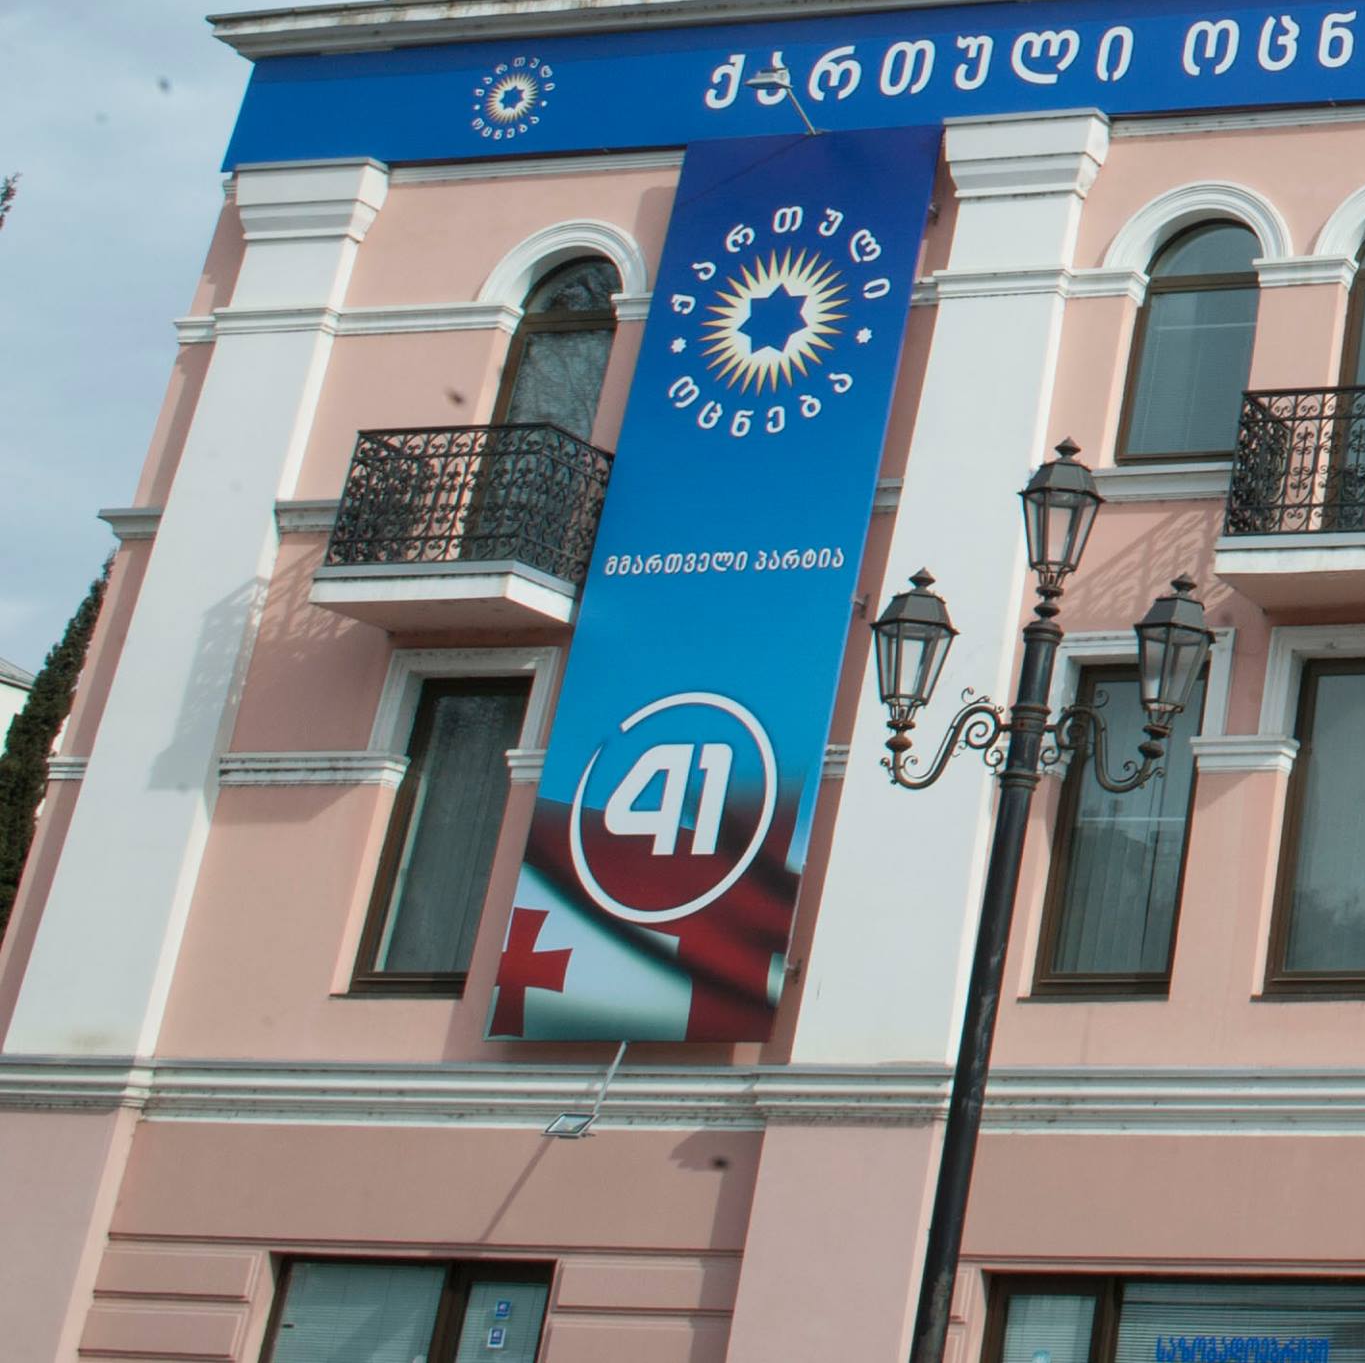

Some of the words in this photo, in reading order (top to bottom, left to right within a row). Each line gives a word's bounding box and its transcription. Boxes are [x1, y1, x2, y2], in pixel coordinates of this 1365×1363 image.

[704, 25, 1134, 110] ქართული
[670, 205, 892, 316] ქართული
[667, 371, 855, 438] ოცნება
[604, 550, 749, 576] მმართველი
[754, 547, 845, 571] პარტია
[604, 743, 733, 856] 41
